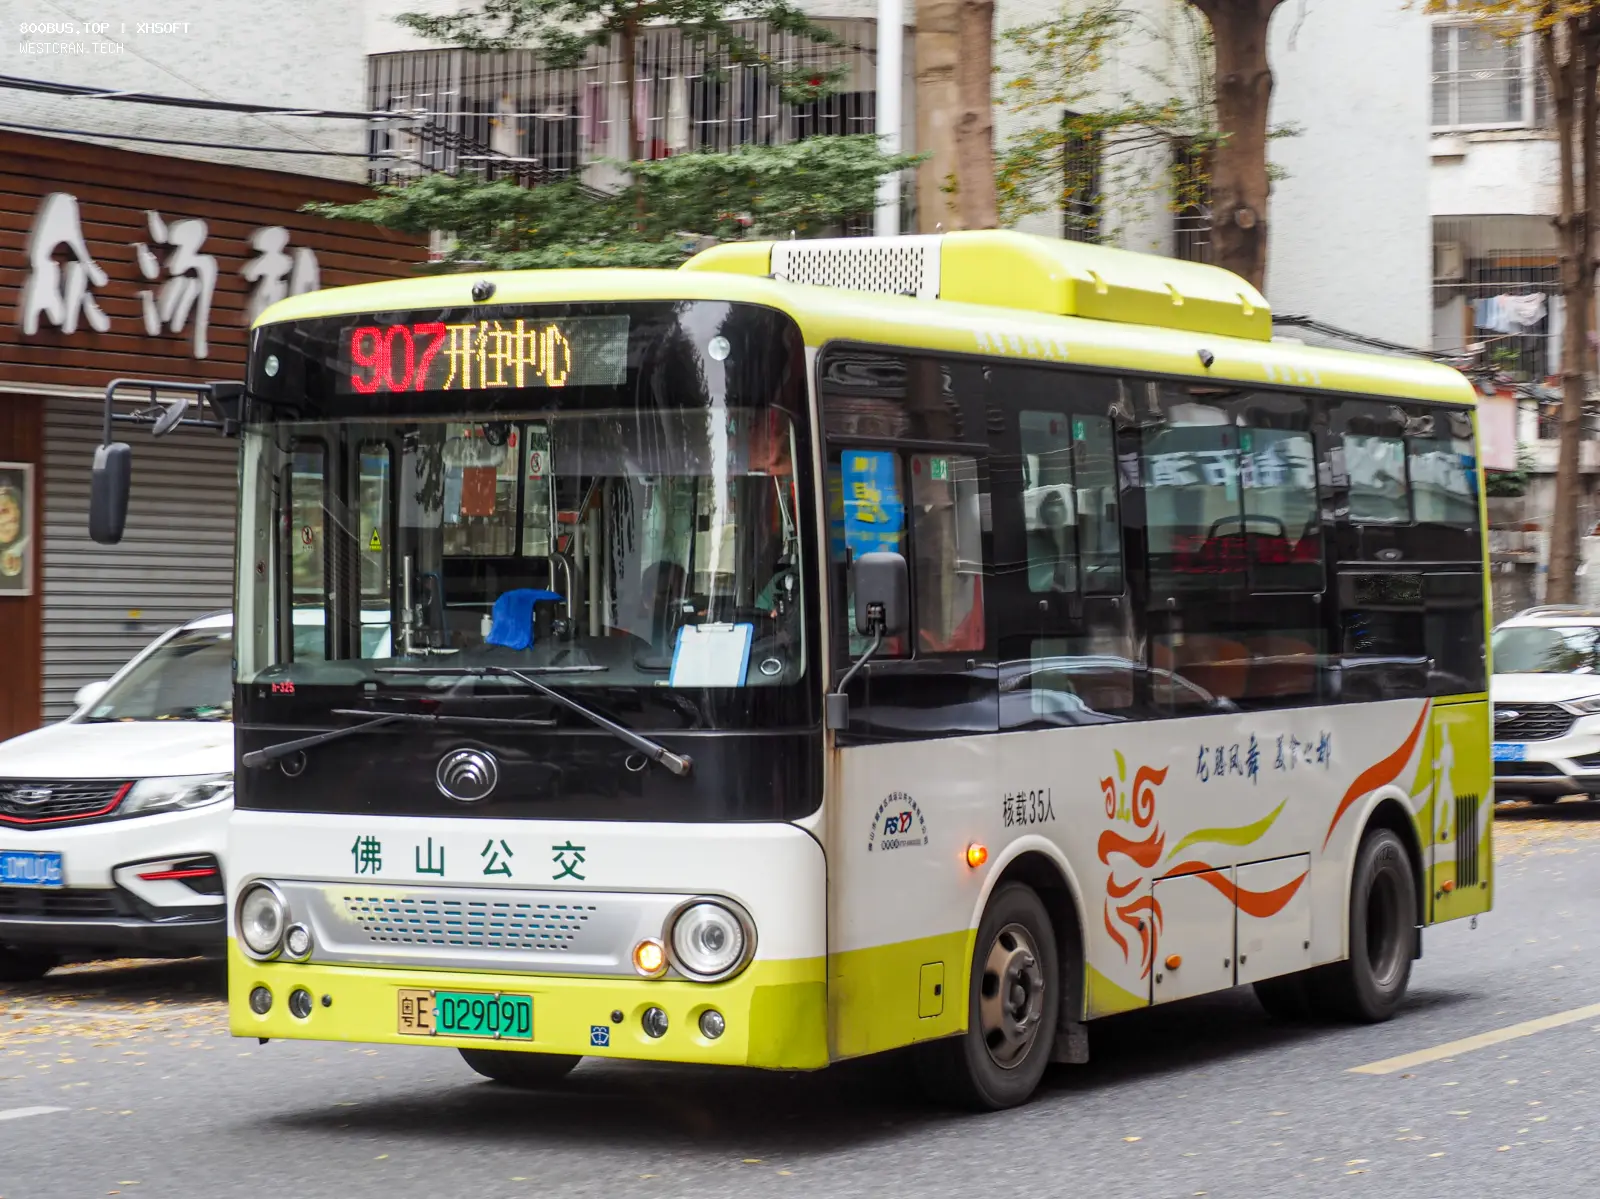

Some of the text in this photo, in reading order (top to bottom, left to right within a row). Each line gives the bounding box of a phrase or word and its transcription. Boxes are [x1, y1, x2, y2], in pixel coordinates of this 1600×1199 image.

[1003, 787, 1056, 828] 核载35人
[351, 835, 586, 881] 佛山公交
